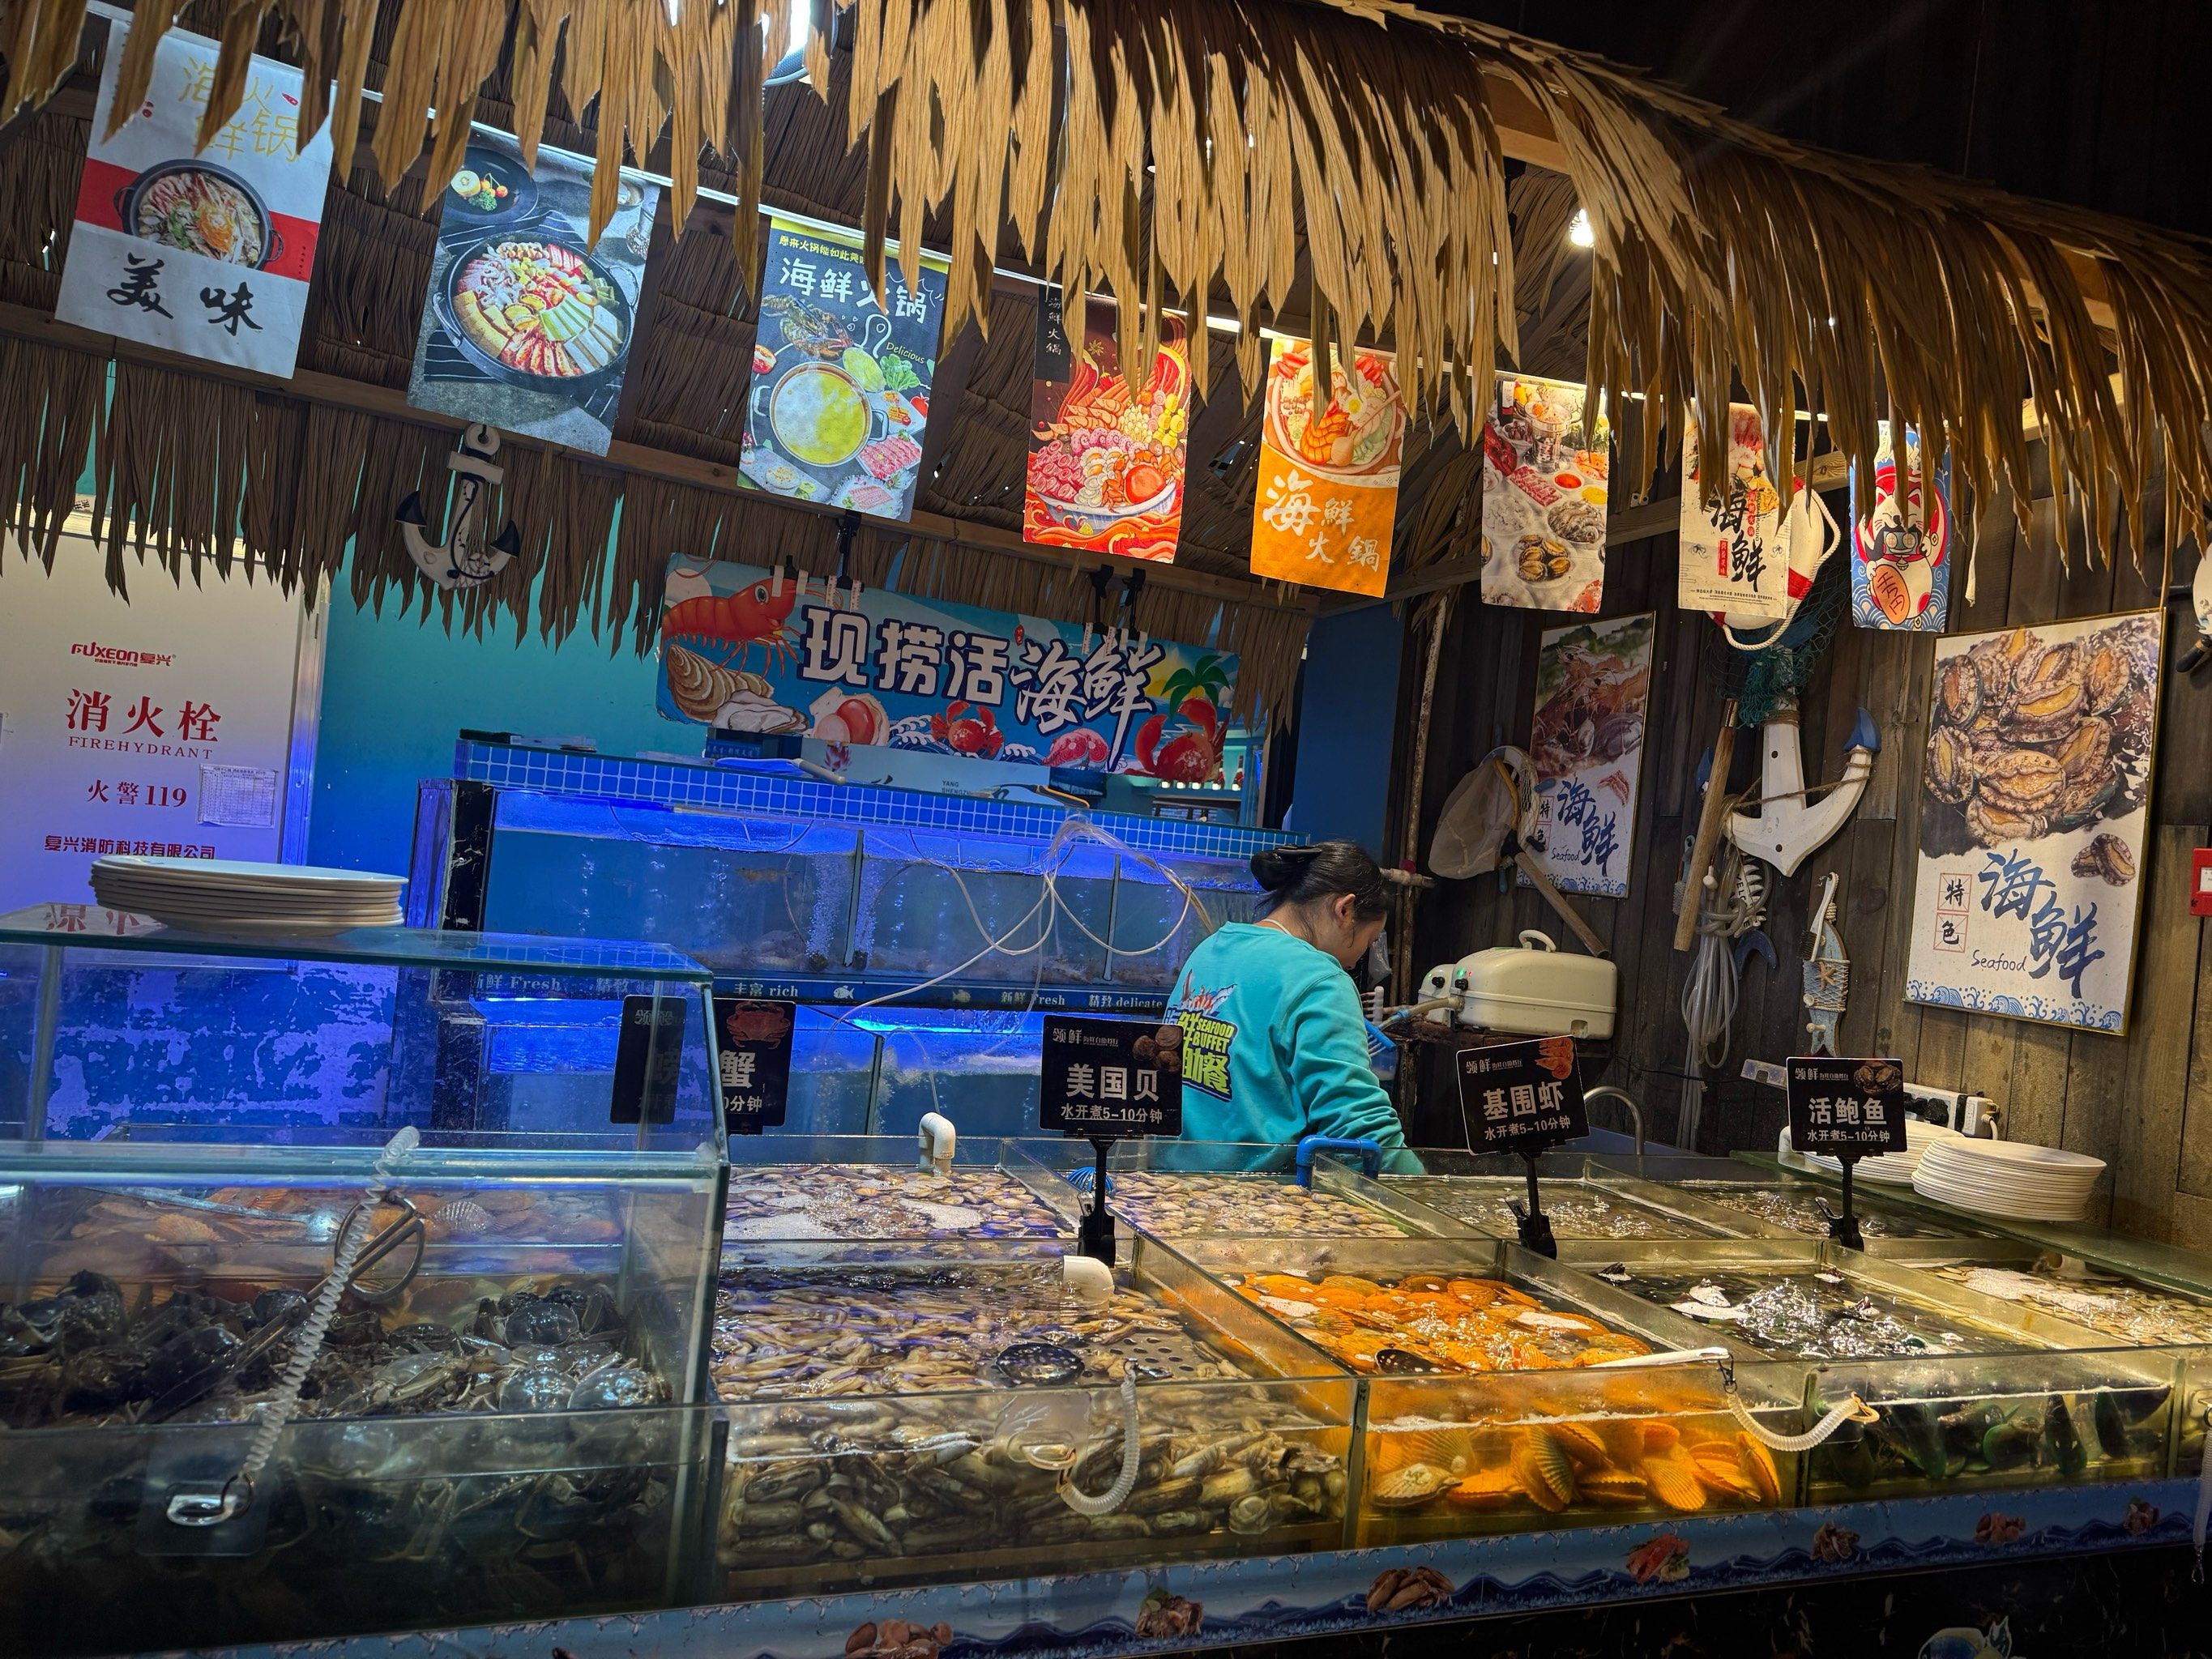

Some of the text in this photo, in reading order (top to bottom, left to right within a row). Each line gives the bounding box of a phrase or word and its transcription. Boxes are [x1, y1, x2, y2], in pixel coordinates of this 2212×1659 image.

[107, 253, 263, 336] 美味
[779, 258, 927, 324] 海鲜火锅
[886, 342, 925, 364] Delicious
[71, 642, 139, 663] FUXEON
[800, 606, 1167, 774] 现捞活海鲜
[66, 689, 221, 742] 消火栓
[69, 736, 212, 760] FIREHYDRANT
[1557, 777, 1619, 876] 海鲜
[45, 835, 216, 859] 复兴消防科技有限公司
[1552, 847, 1580, 862] Seafood
[1942, 878, 1964, 945] 特色
[1978, 848, 2105, 999] 海鲜
[1971, 949, 2027, 971] Seafood
[510, 976, 561, 991] Fresh
[734, 982, 798, 997] 丰富 rich
[1116, 996, 1163, 1009] delicate
[1053, 1027, 1083, 1044] 领鲜
[1196, 1017, 1235, 1038] SEAFOOD
[1192, 1031, 1230, 1054] BUFFET
[1466, 1059, 1491, 1074] 领鲜
[1795, 1068, 1818, 1081] 领鲜
[1065, 1063, 1159, 1102] 美国贝
[1483, 1081, 1564, 1120] 基围虾
[1808, 1097, 1887, 1125] 活鲍鱼
[1061, 1102, 1162, 1124] 水开煮5-10分钟
[1484, 1115, 1571, 1141] 水开煮5-10分钟
[1807, 1129, 1890, 1143] 水开煮5-10分钟
